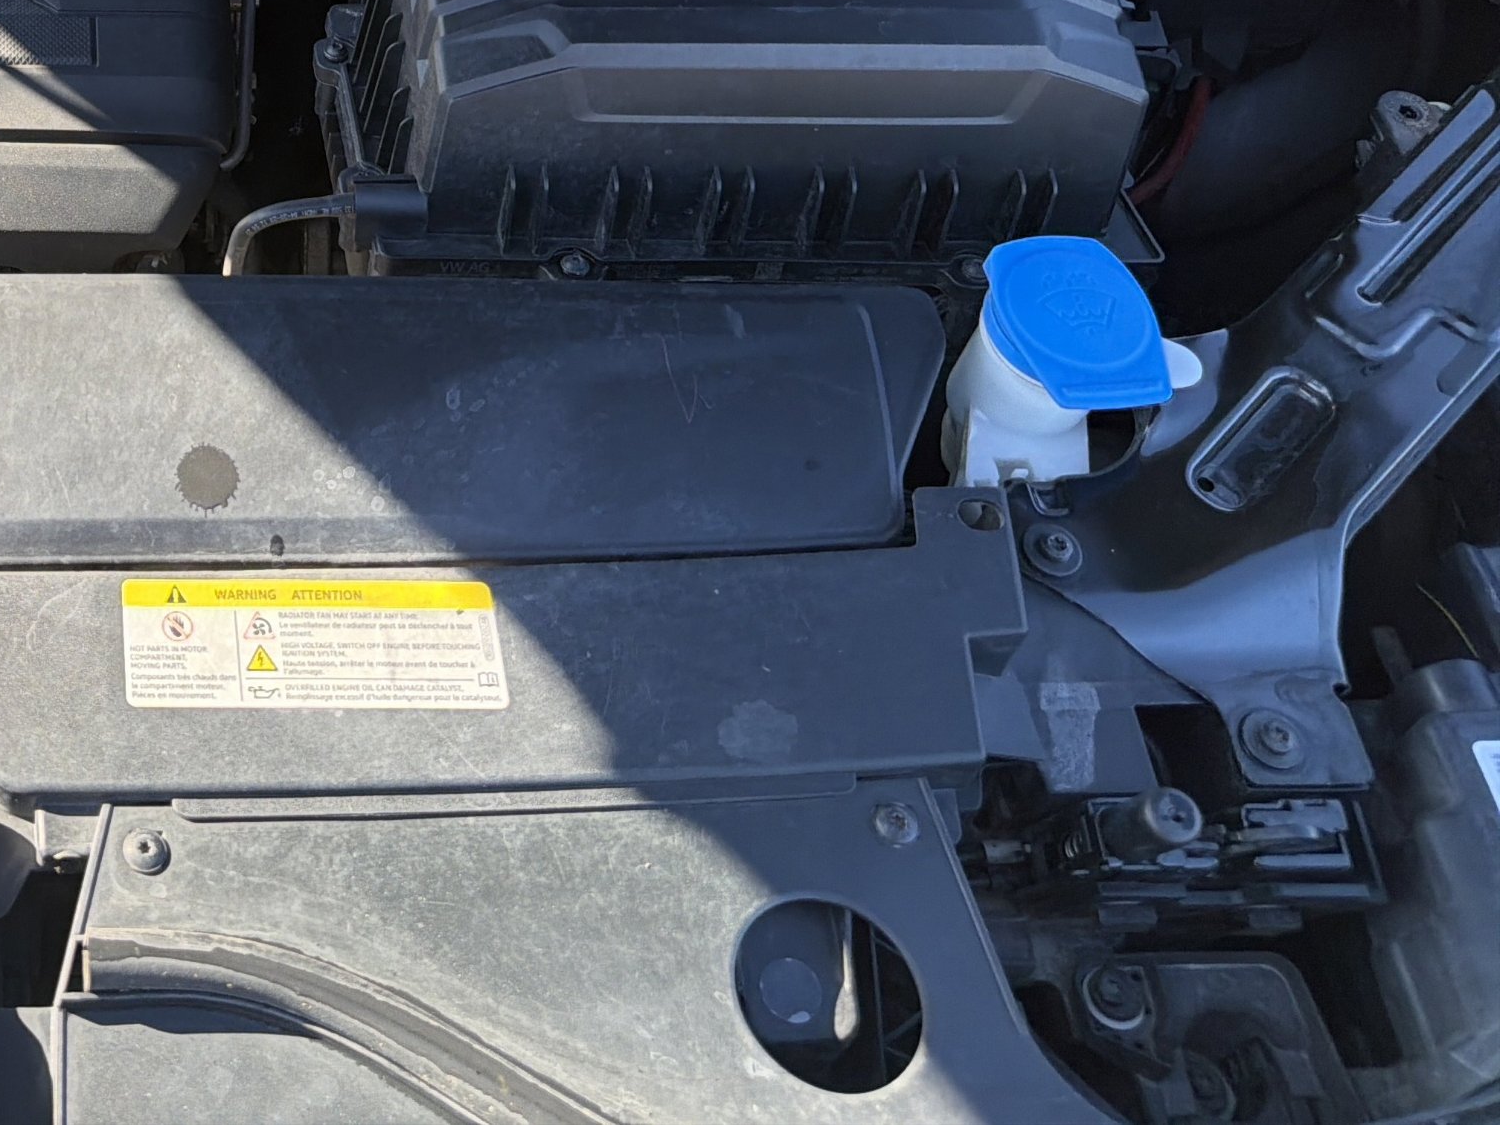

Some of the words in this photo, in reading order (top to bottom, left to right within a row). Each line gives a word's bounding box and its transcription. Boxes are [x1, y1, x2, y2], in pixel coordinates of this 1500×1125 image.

[214, 589, 277, 600] WARNING
[292, 589, 362, 600] ATTENTION
[286, 693, 332, 702] Remplissage
